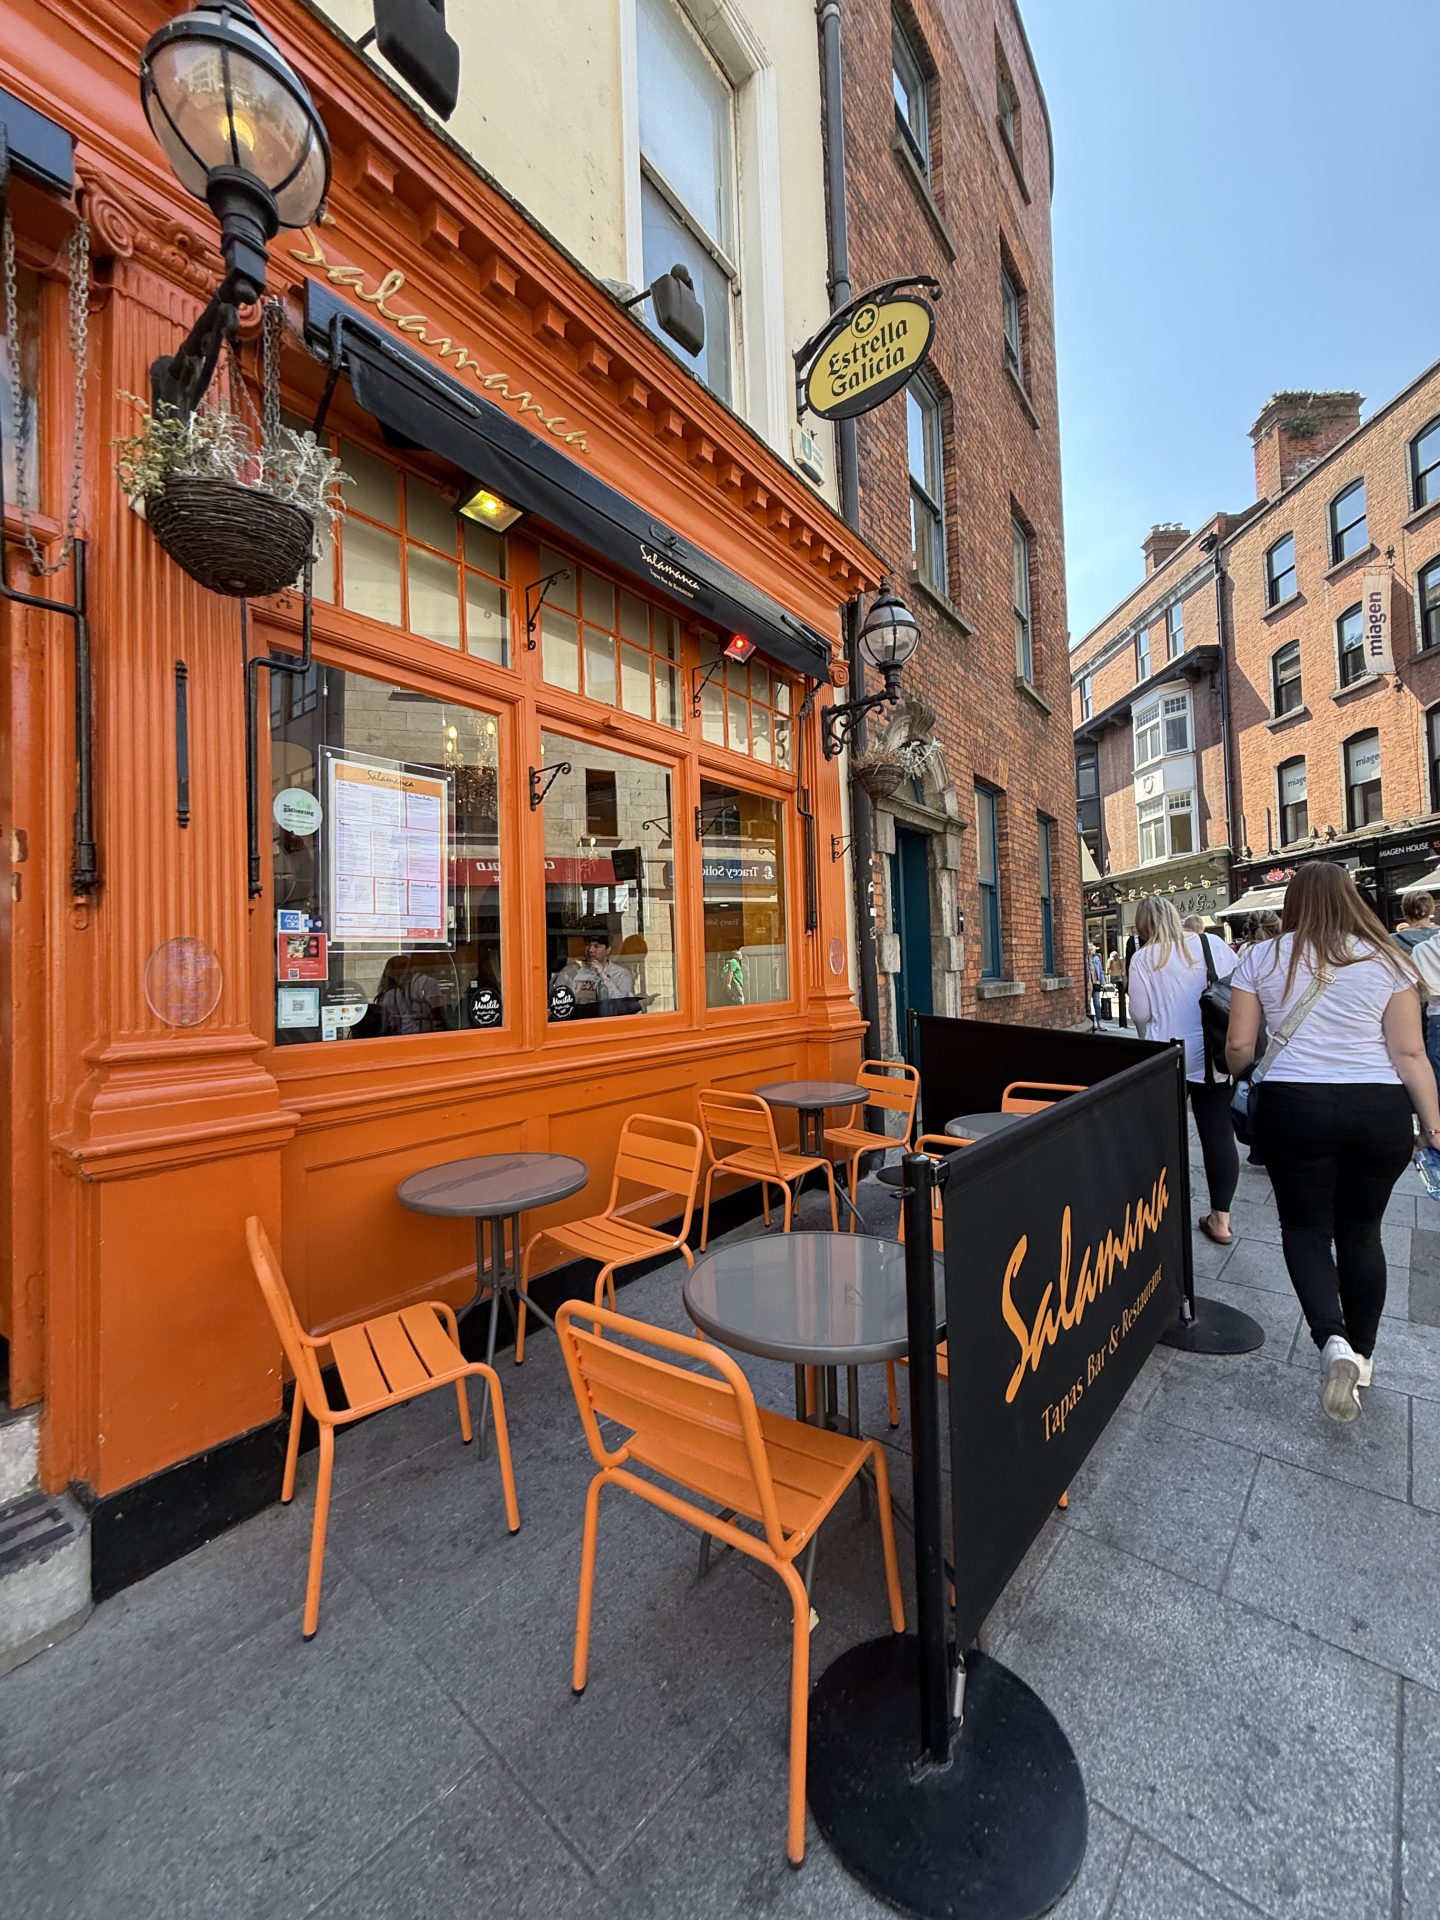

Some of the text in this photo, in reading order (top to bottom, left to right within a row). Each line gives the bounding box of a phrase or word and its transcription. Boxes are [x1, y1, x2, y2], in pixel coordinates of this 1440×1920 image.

[289, 214, 591, 454] Salamanca
[828, 319, 908, 378] Estrella
[831, 347, 905, 397] Galicia
[640, 544, 700, 590] Salamanca
[1366, 591, 1387, 657] miagen
[283, 807, 314, 817] gathering
[1379, 846, 1405, 858] MIAGEN
[1405, 841, 1430, 853] HOUSE
[1002, 1165, 1170, 1404] Salamanca
[1041, 1263, 1163, 1442] Tapas Bar & Restaurant
